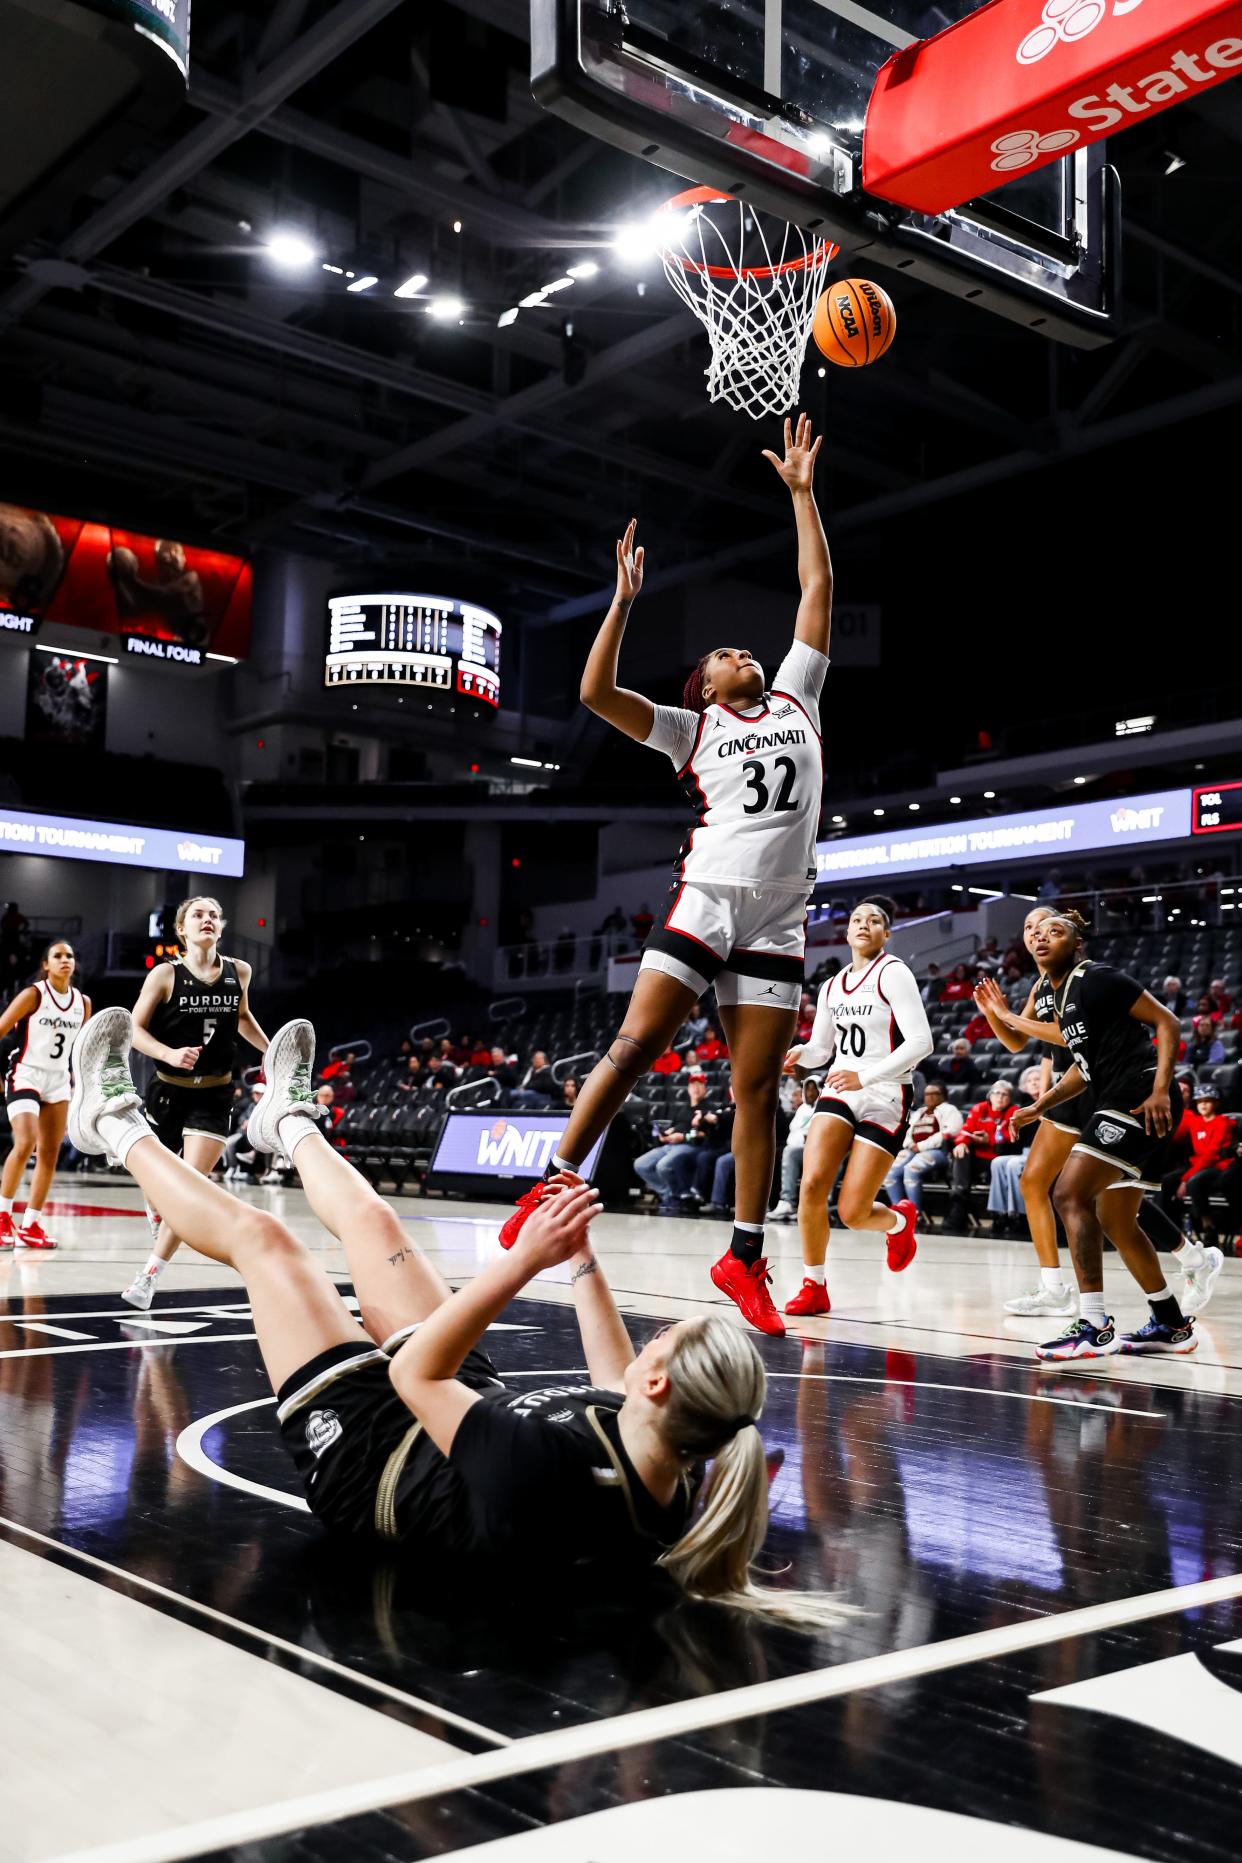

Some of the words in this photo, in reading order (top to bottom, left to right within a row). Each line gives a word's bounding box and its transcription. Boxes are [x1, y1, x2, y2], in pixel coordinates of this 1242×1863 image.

[1068, 38, 1242, 131] State
[837, 296, 859, 338] NCAA
[128, 638, 165, 658] FINAL
[167, 645, 201, 664] FOUR
[718, 730, 806, 758] CINCINNATI
[743, 756, 799, 814] 32
[1110, 807, 1164, 832] WNIT
[36, 827, 145, 855] TOURNAMENT
[968, 820, 1075, 851] TOURNAMENT
[177, 841, 223, 864] WNIT
[179, 995, 239, 1006] PURDUE
[49, 1033, 65, 1059] 3
[203, 1018, 218, 1046] 5
[836, 1023, 866, 1057] 20
[477, 1124, 563, 1168] WNIT
